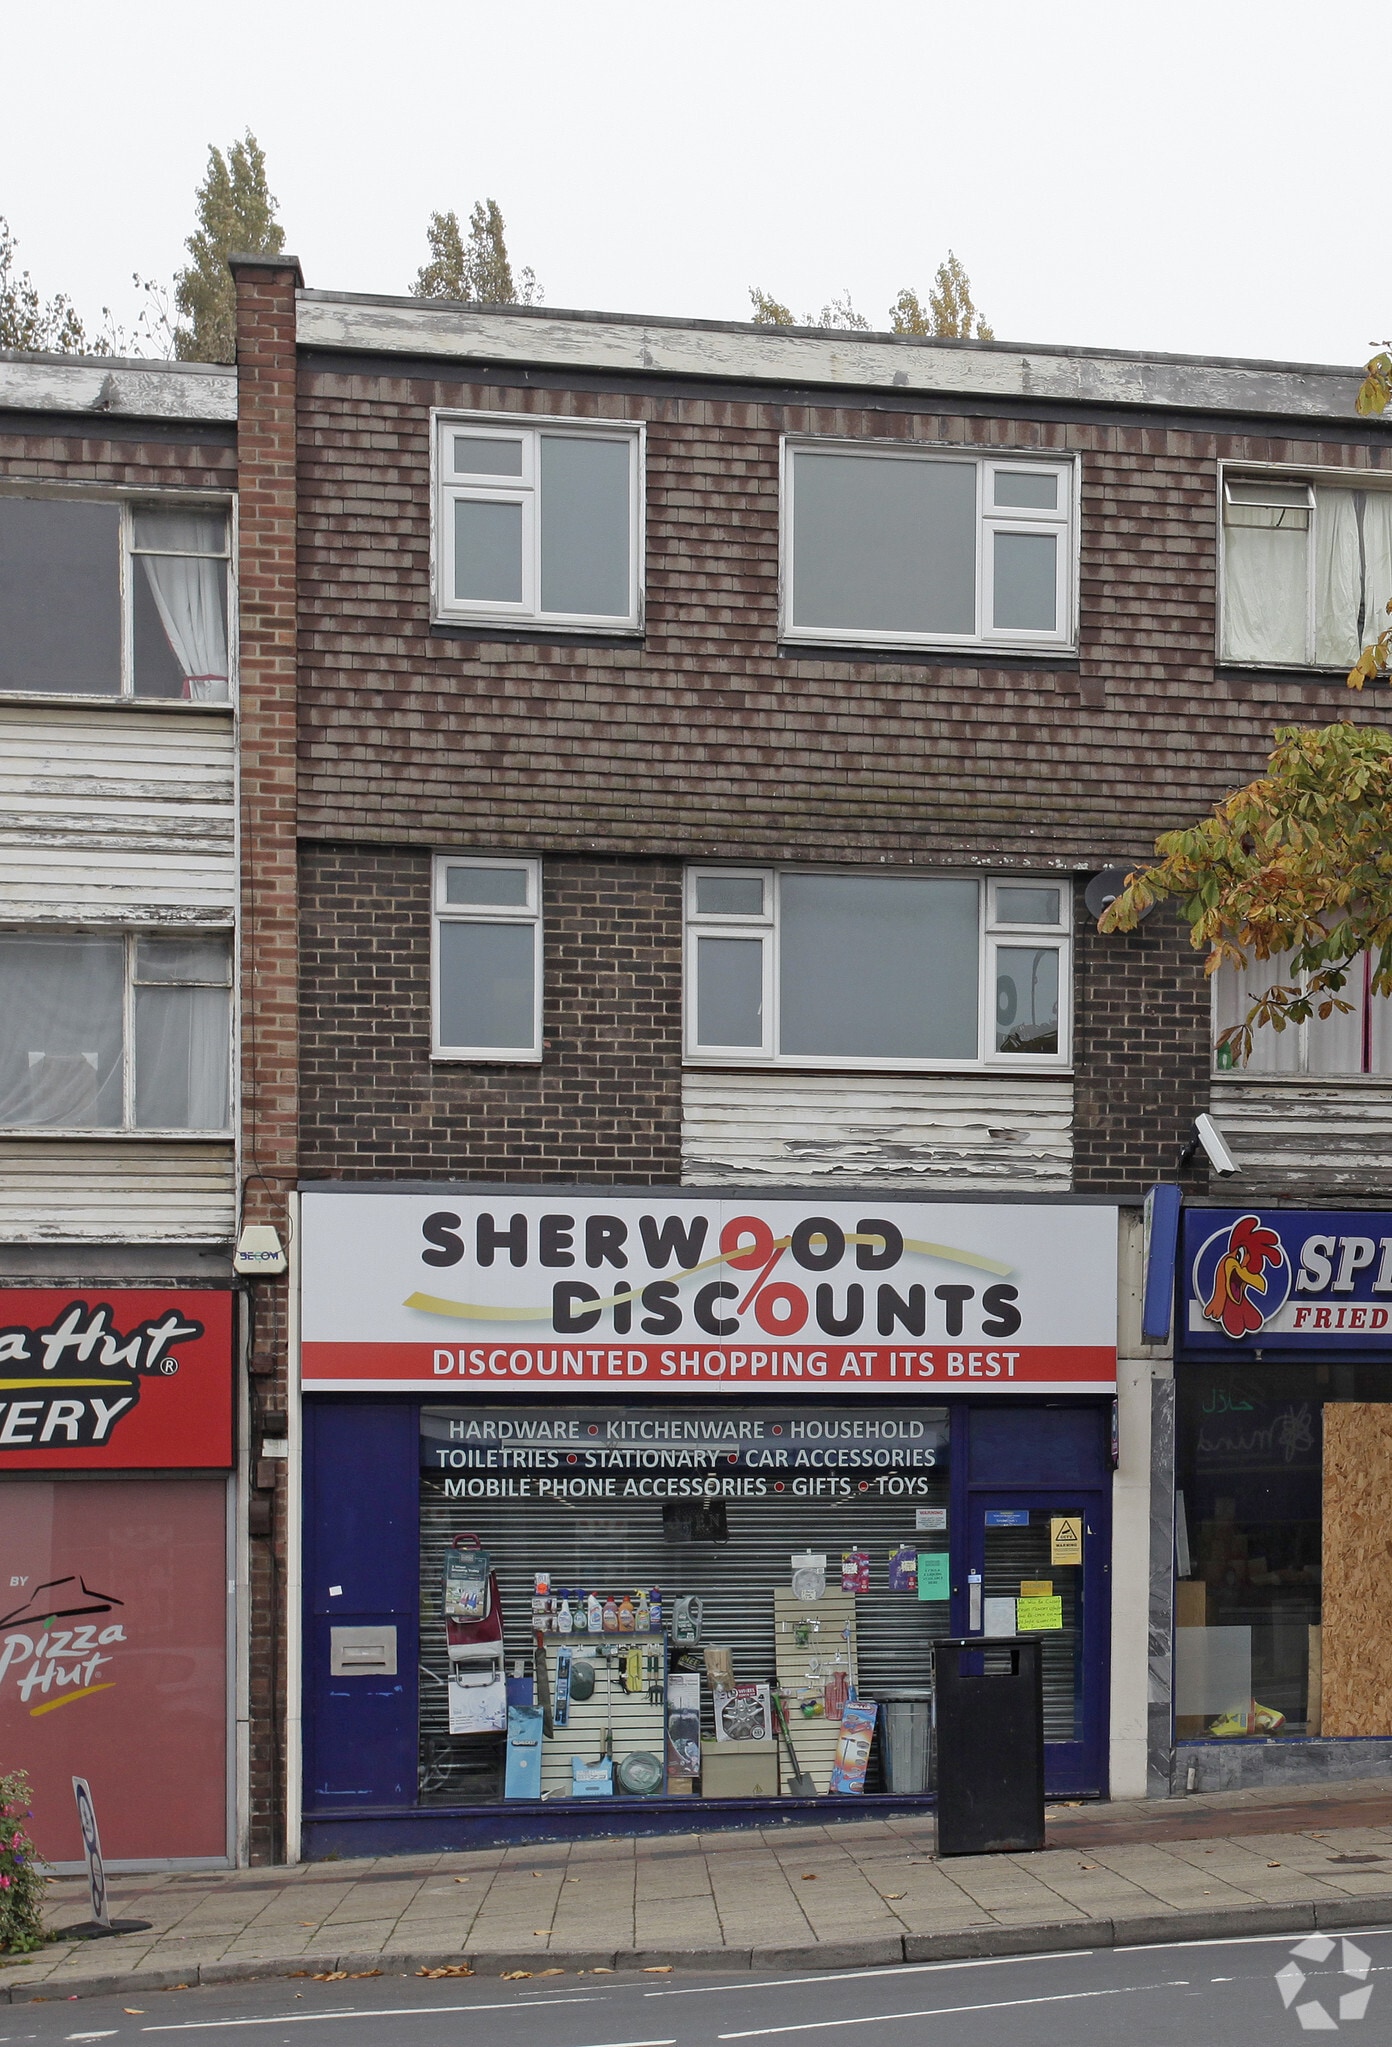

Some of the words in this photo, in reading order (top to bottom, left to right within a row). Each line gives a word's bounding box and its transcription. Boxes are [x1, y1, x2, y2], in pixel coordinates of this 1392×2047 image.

[421, 1211, 904, 1272] SHERWOOD
[240, 1251, 279, 1261] SECOM
[552, 1280, 1022, 1338] DISCOUNTS
[1293, 1307, 1389, 1329] FRIED
[432, 1349, 649, 1376] DISCOUNTED
[660, 1350, 828, 1377] SHOPPING
[839, 1352, 878, 1377] AT
[890, 1352, 935, 1377] ITS
[947, 1352, 1021, 1377] BEST
[0, 1397, 133, 1444] ERY
[449, 1420, 580, 1440] HARDWARE
[606, 1420, 765, 1440] KITCHENWARE
[790, 1420, 924, 1439] HOUSEHOLD
[436, 1449, 559, 1469] TOILETRIES
[584, 1449, 720, 1468] STATIONARY
[745, 1449, 791, 1467] CAR
[794, 1449, 936, 1468] ACCESSORIES
[444, 1477, 531, 1497] MOBILE
[538, 1477, 616, 1497] PHONE
[623, 1477, 767, 1496] ACCESSORIES
[792, 1477, 852, 1495] GIFTS
[876, 1477, 928, 1495] TOYS
[9, 1576, 29, 1587] BY
[0, 1618, 127, 1685] Pizza
